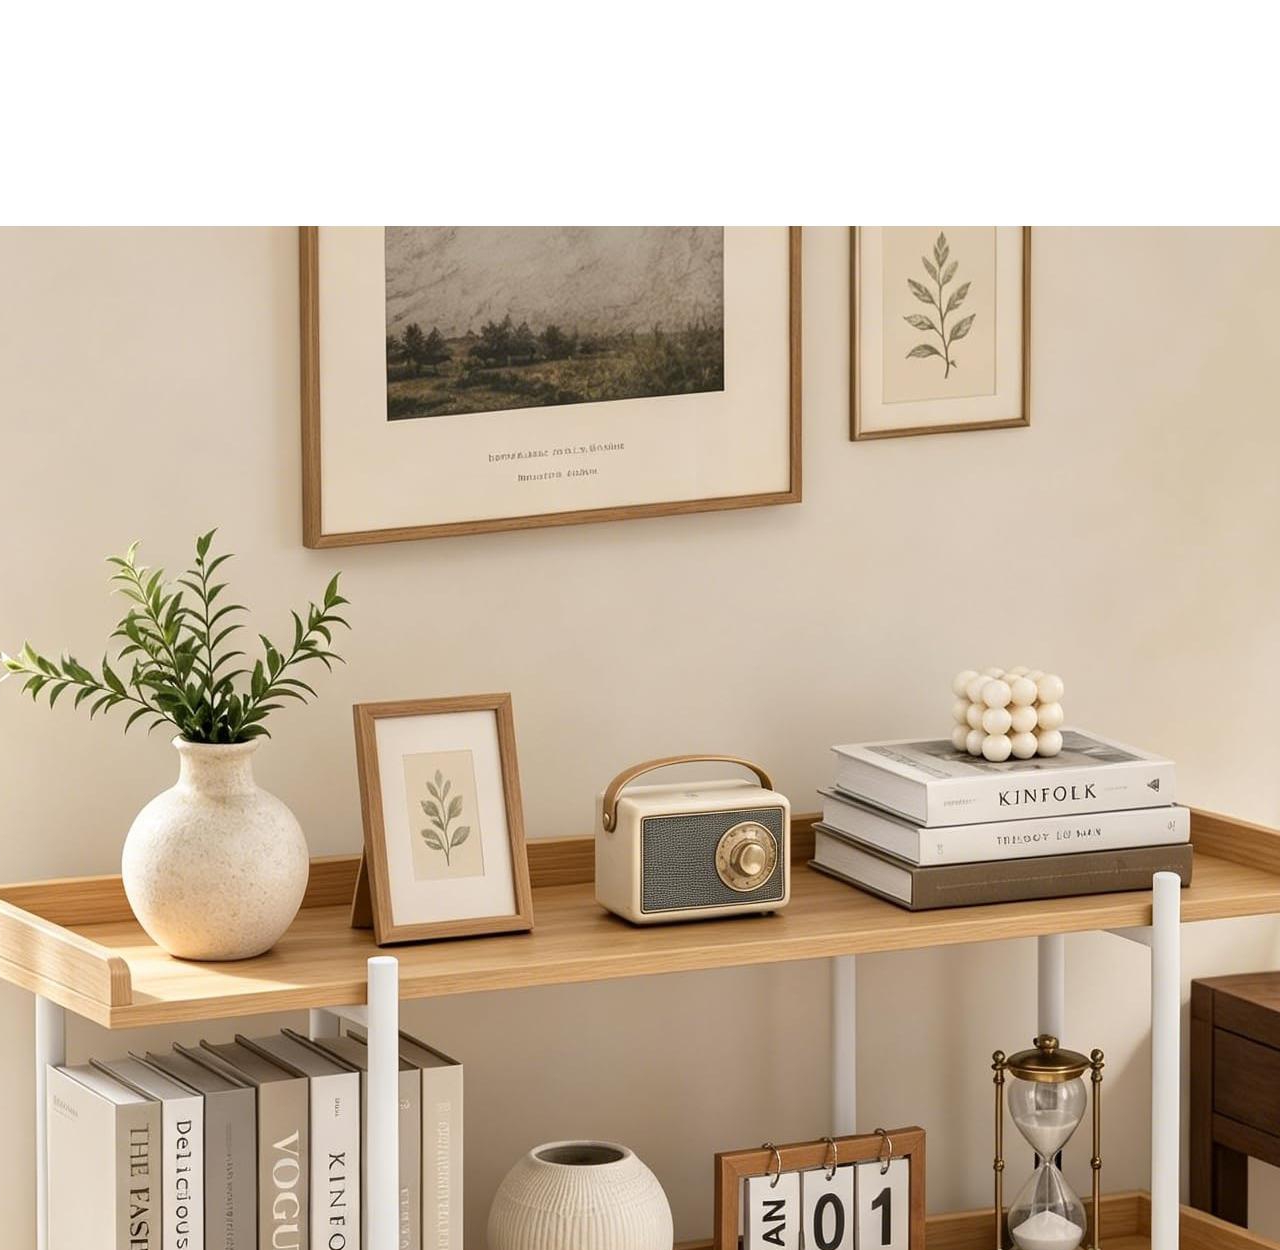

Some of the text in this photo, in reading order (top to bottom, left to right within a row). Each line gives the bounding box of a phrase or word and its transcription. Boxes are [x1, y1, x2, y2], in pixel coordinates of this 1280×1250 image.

[999, 783, 1097, 806] KINFOLK
[129, 1122, 150, 1177] THE
[175, 1120, 192, 1249] Delicious
